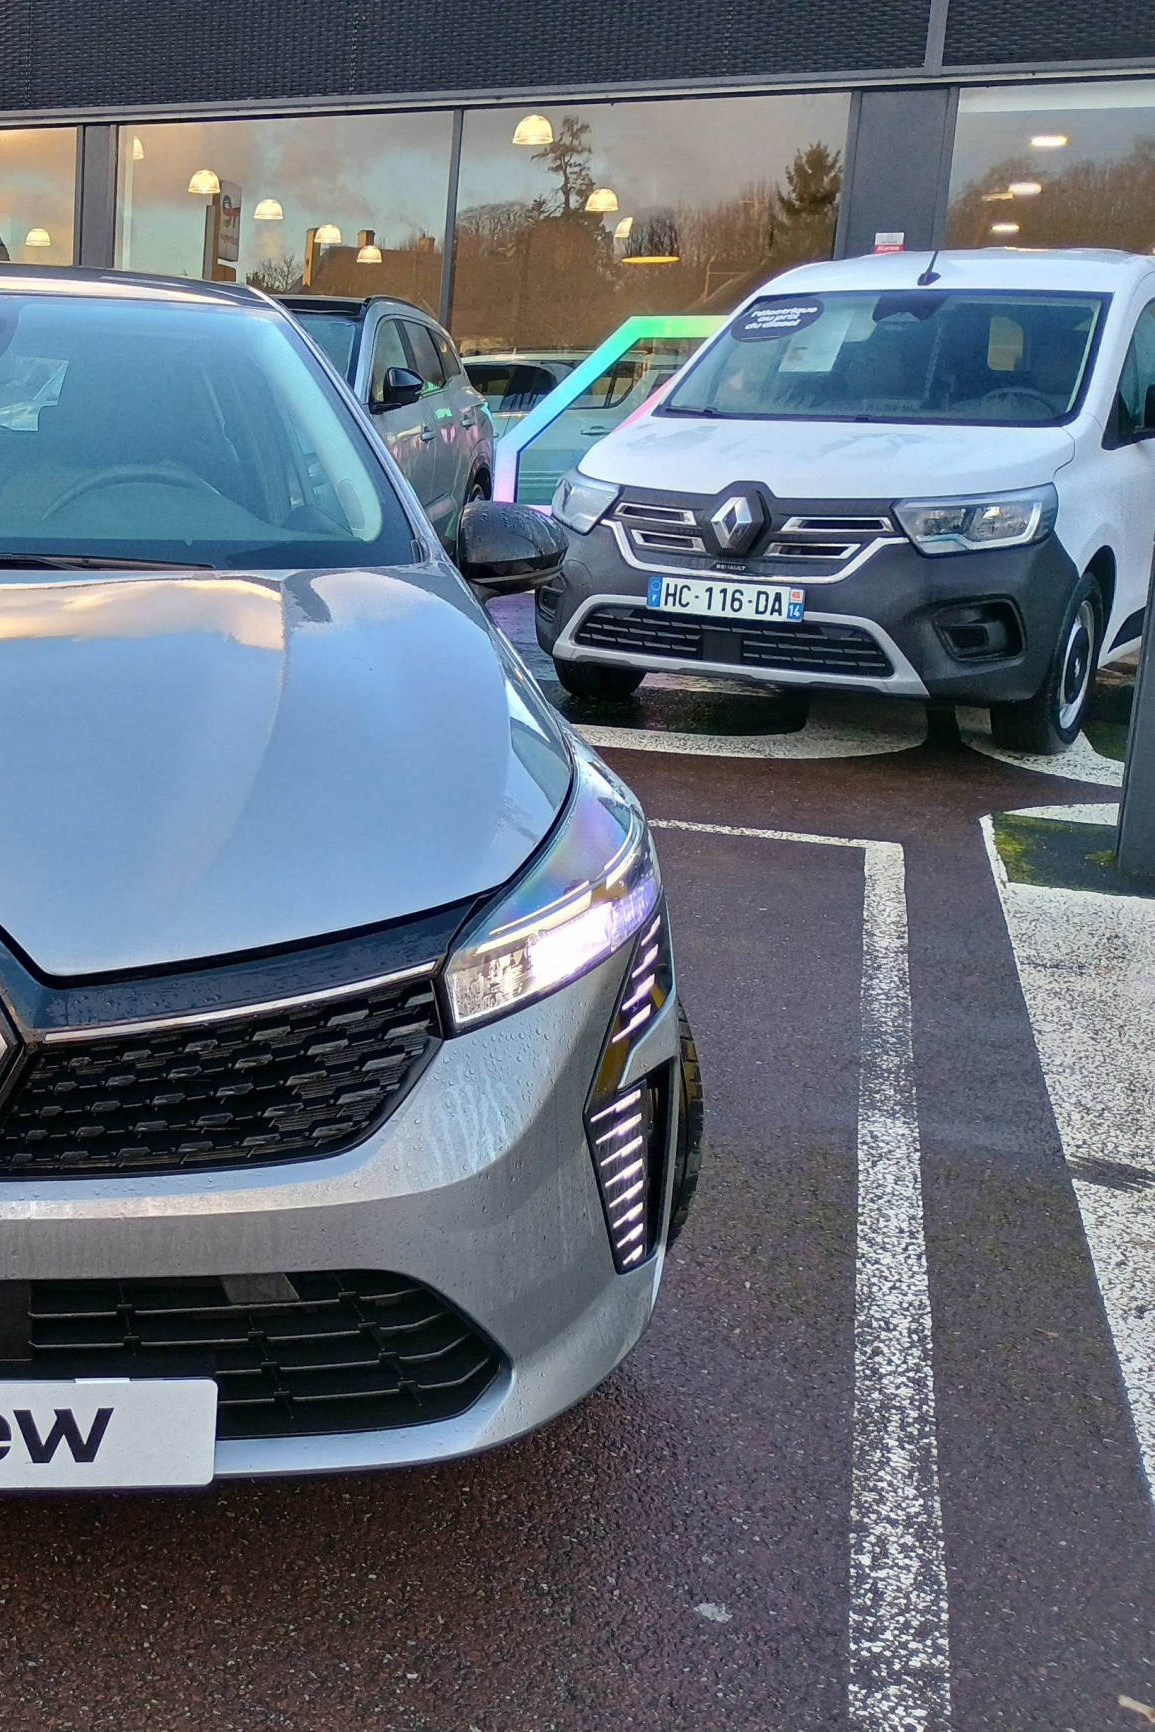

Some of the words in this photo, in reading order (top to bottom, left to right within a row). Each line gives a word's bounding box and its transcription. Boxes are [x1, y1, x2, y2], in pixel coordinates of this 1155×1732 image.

[757, 315, 775, 323] au
[744, 321, 763, 330] du
[664, 582, 783, 616] HC-116-DA
[788, 603, 801, 617] 14
